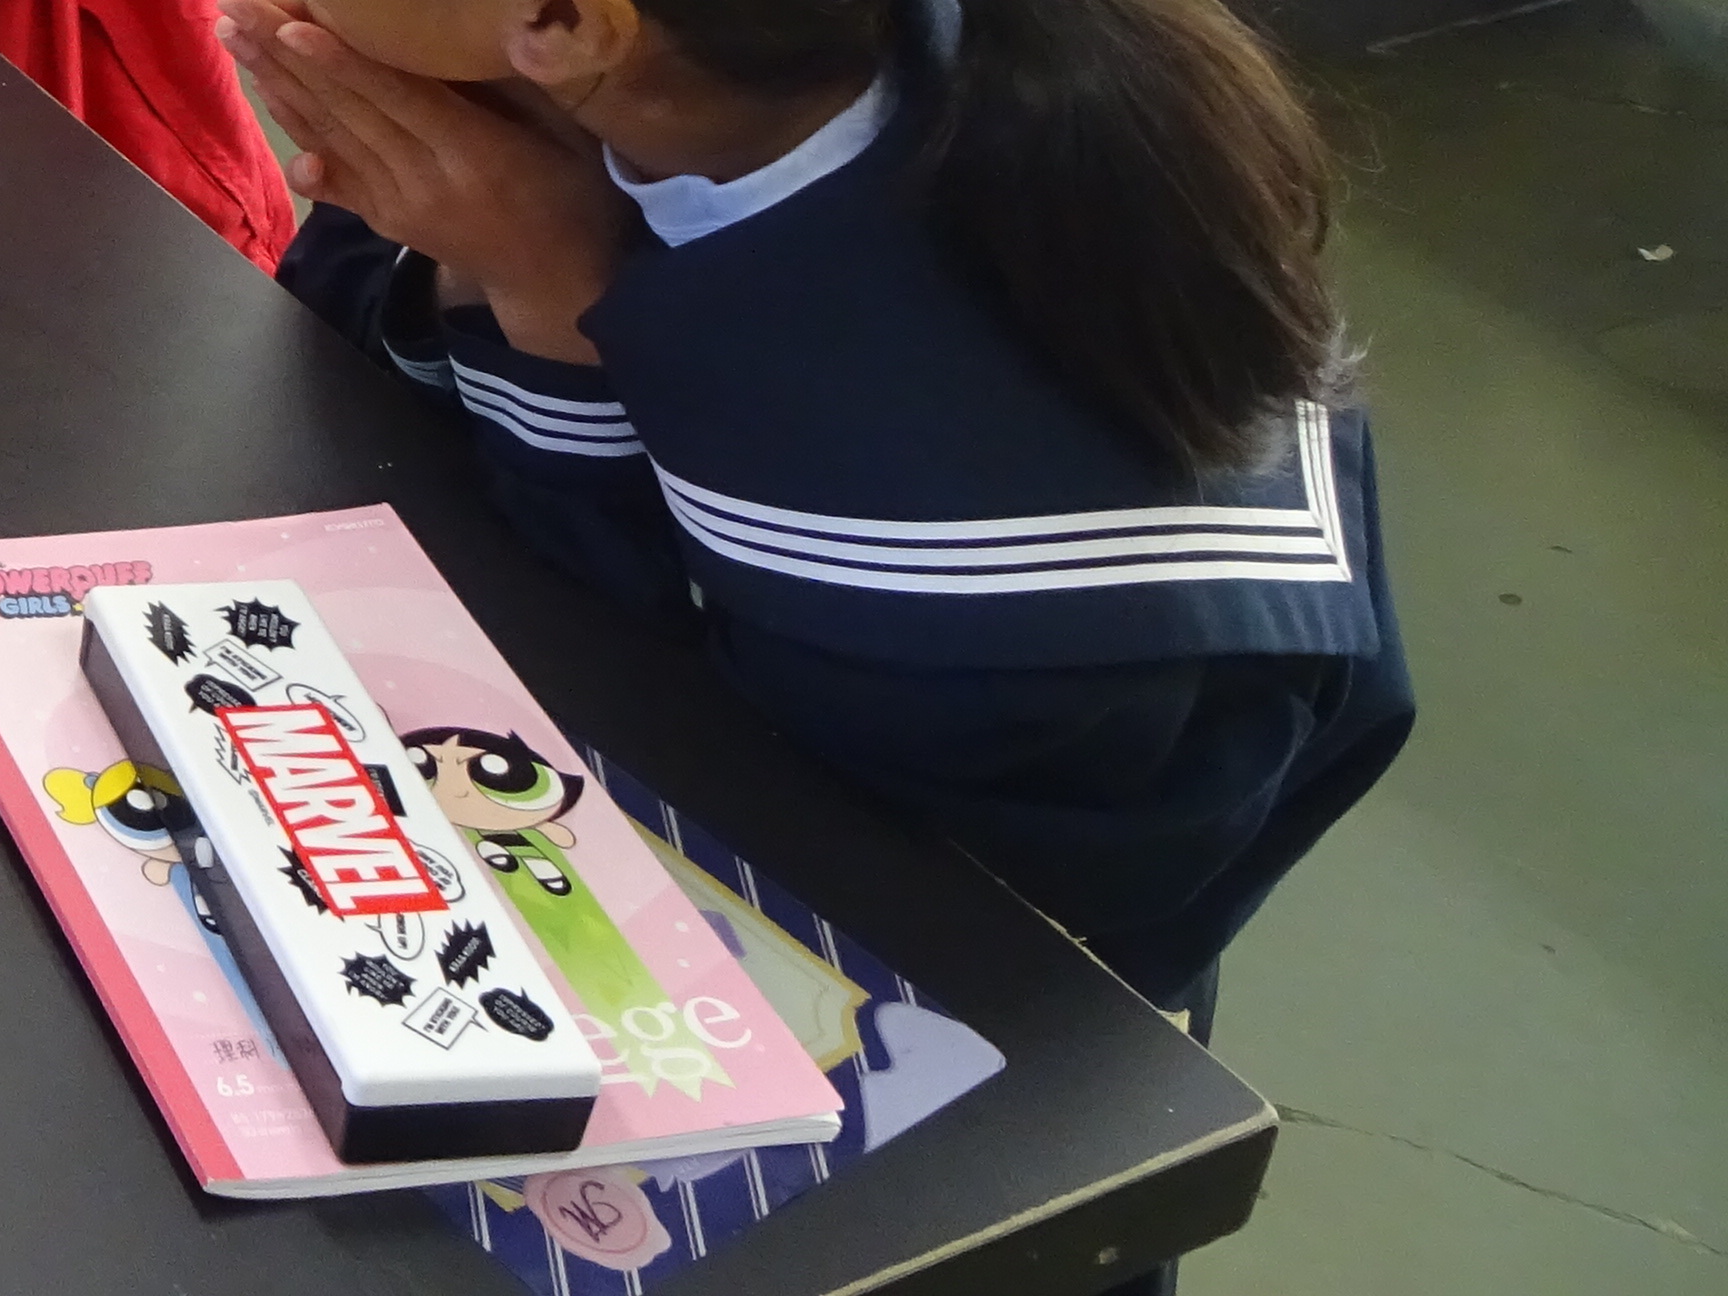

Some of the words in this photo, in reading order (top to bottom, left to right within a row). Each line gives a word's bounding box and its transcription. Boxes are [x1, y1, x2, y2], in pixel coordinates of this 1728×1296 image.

[224, 708, 431, 912] MARVEL
[211, 1038, 260, 1064] 理科
[216, 1073, 256, 1098] 6.5
